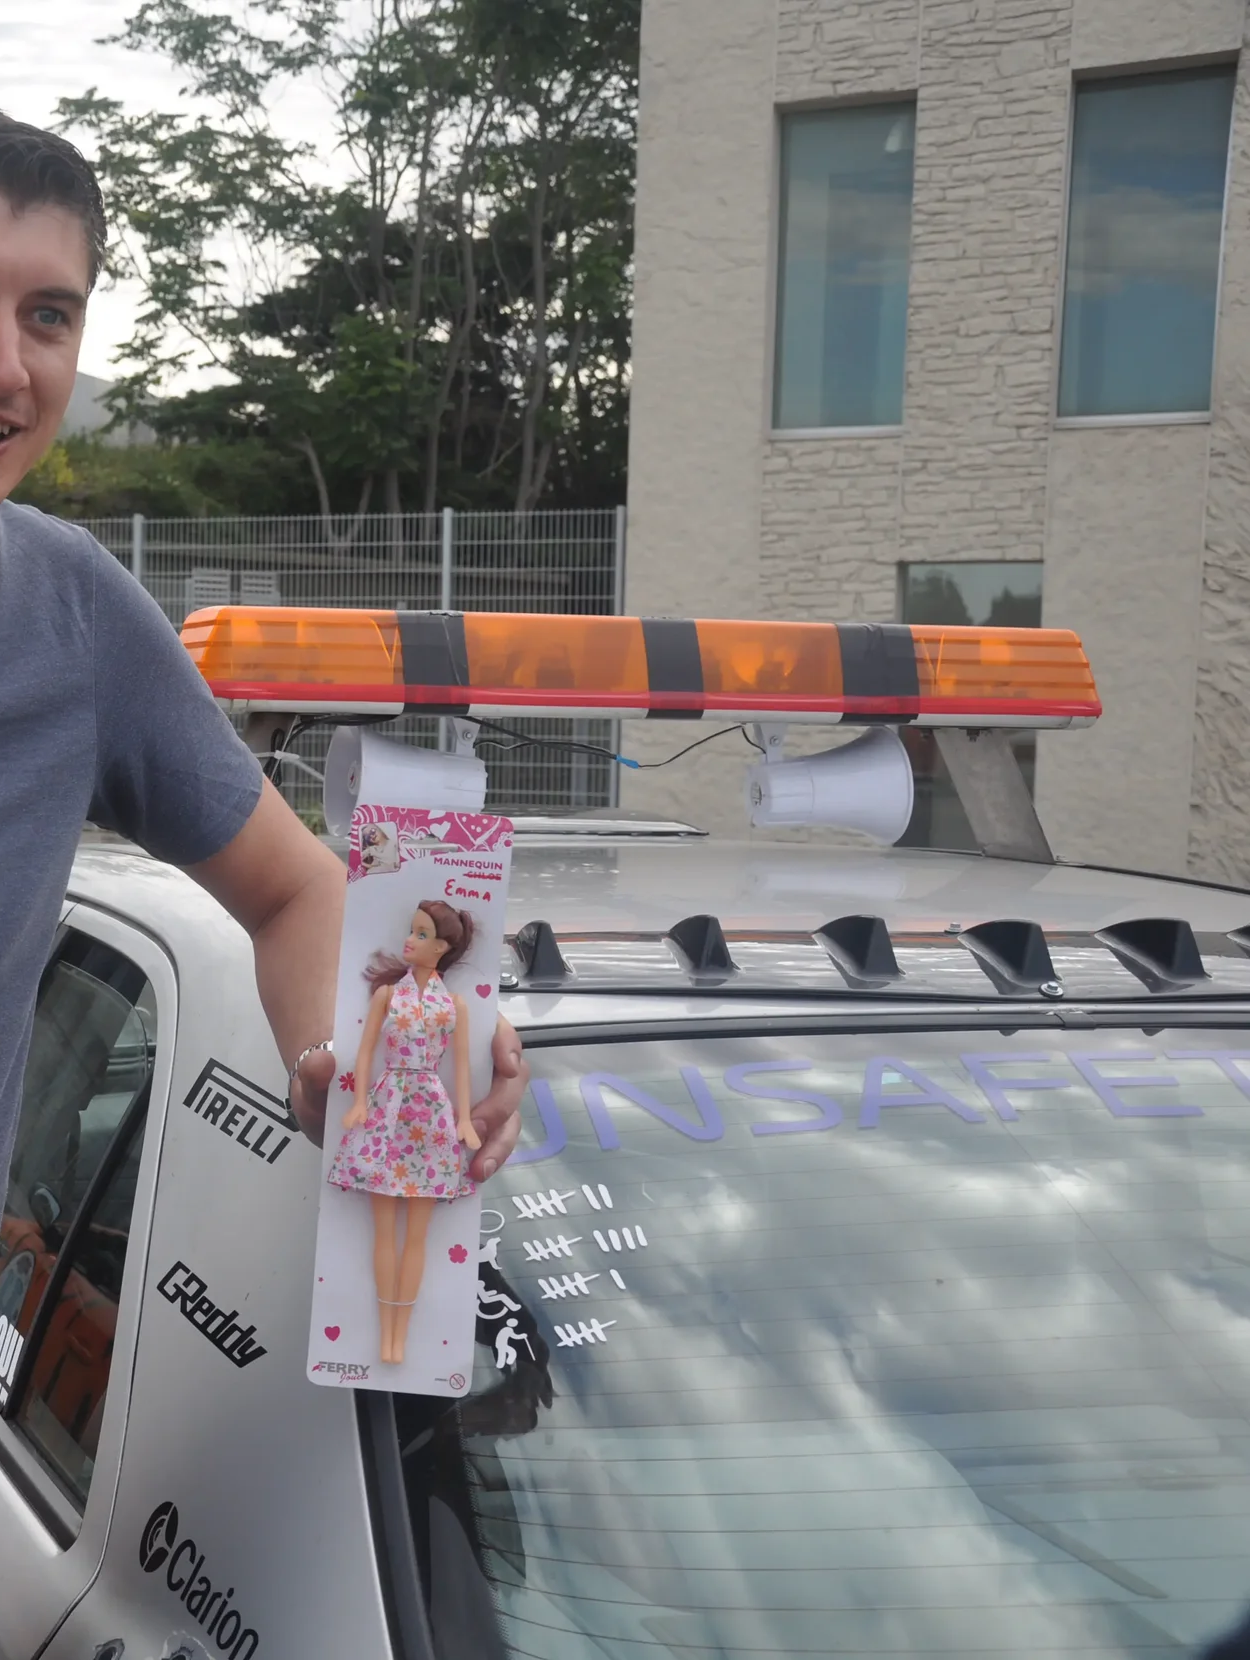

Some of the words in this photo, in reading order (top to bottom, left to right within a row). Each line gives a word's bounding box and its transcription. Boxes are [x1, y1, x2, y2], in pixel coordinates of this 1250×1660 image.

[433, 856, 503, 871] MANNEQUIN
[182, 1057, 302, 1165] PIRELLI
[318, 1361, 370, 1375] FERRY
[166, 1538, 260, 1660] Clarion
